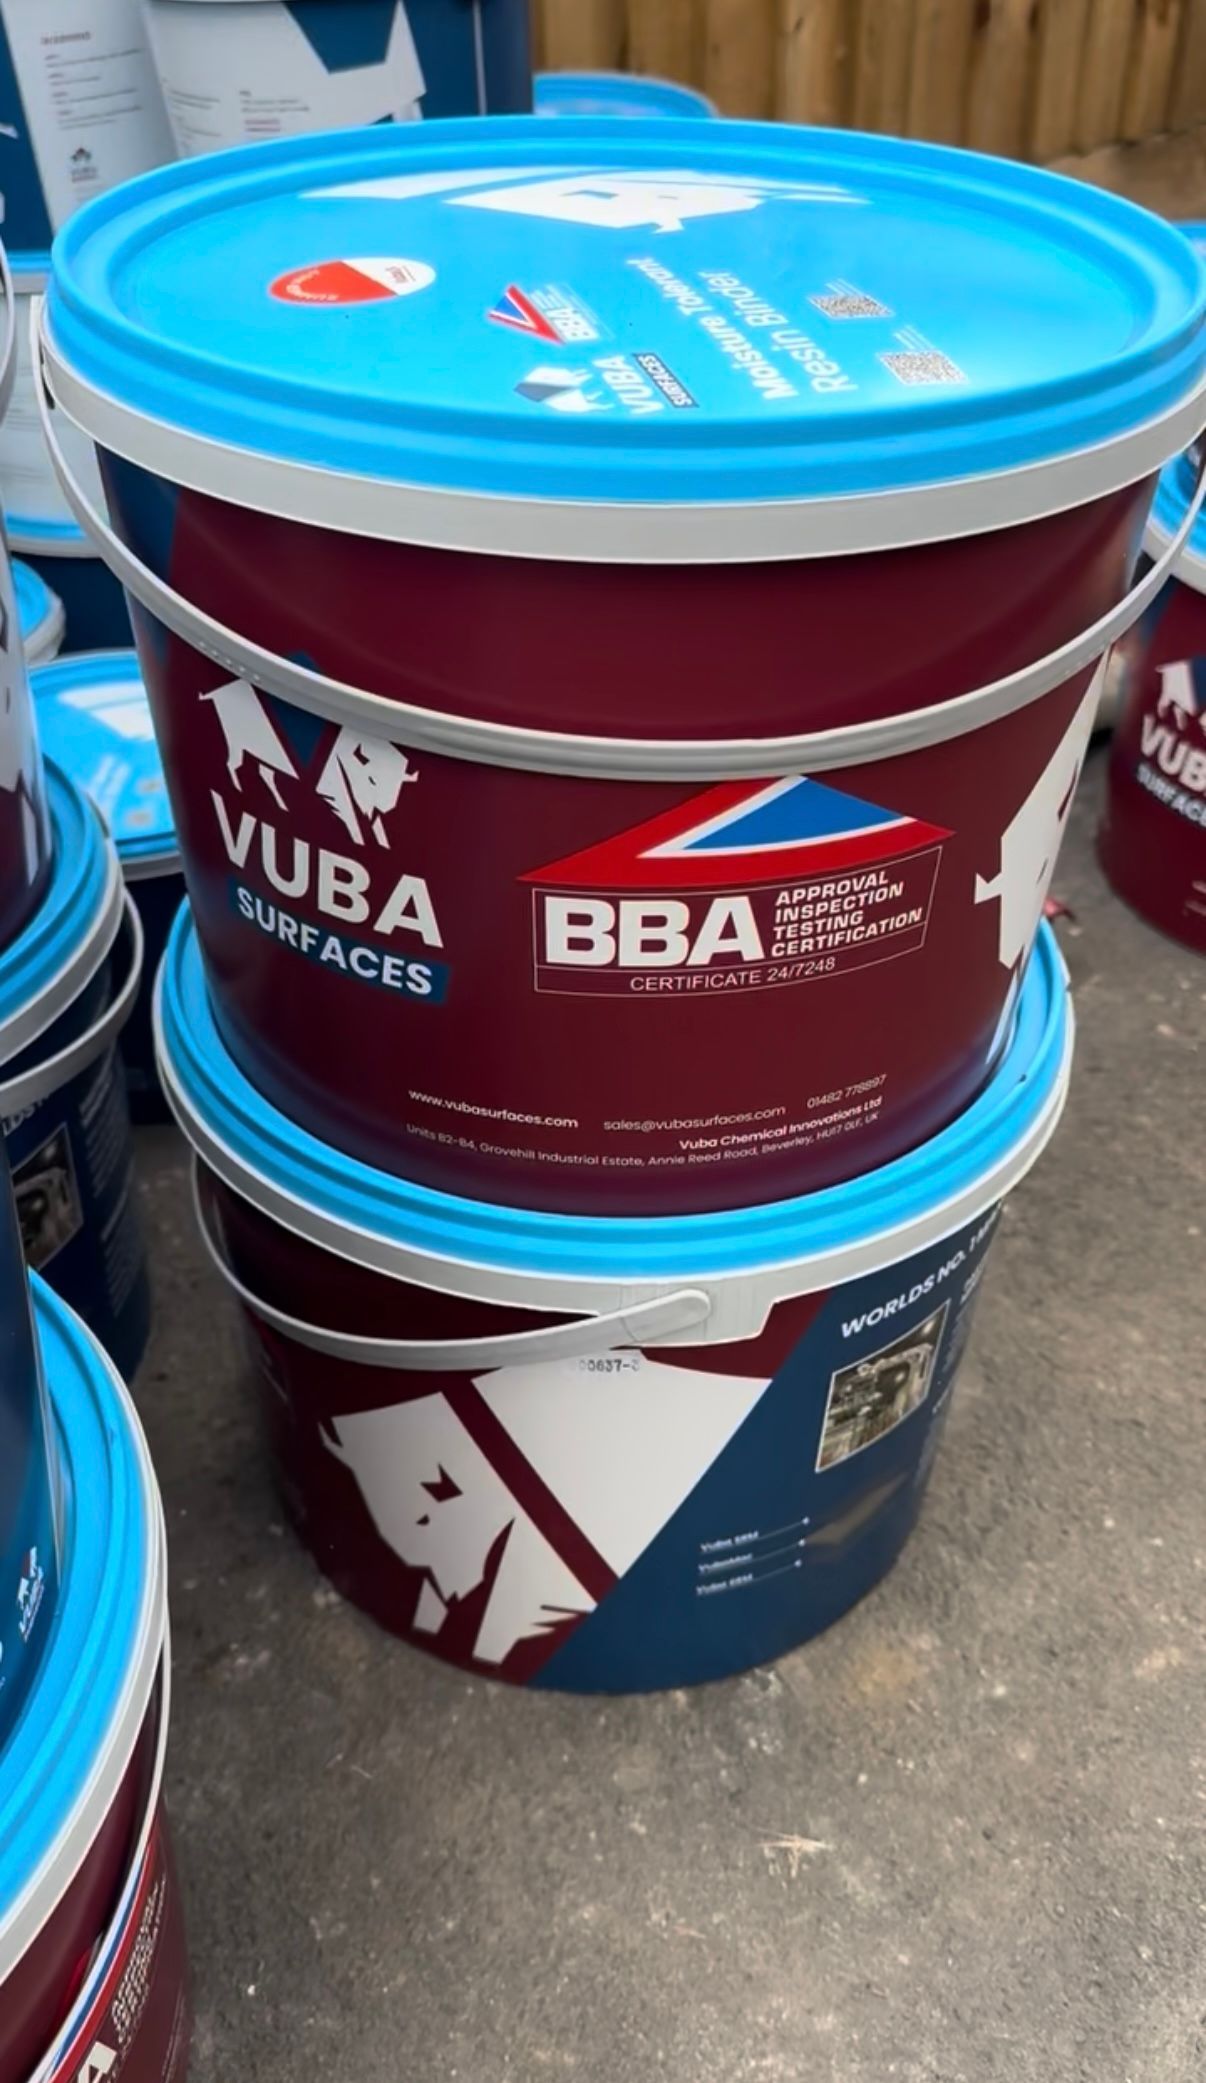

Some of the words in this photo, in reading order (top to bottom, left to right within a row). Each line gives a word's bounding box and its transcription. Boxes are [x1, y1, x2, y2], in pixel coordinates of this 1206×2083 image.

[698, 271, 788, 326] Binder
[592, 356, 665, 413] VUBA
[701, 315, 799, 399] Moisture
[770, 329, 858, 393] Resin
[1141, 713, 1206, 797] VUB
[210, 789, 444, 948] VUBA
[775, 871, 889, 906] APPROVAL
[773, 910, 864, 941] TESTING
[774, 881, 904, 924] INSPECTION
[236, 886, 433, 995] SURFACES
[545, 896, 765, 967] BBA
[771, 907, 923, 958] CERTIFICATION
[630, 970, 761, 992] CERTIFICATE
[767, 956, 836, 982] 24/7248
[408, 1090, 579, 1128] www.vubasurfaces.com
[603, 1106, 786, 1133] sales@vubasurfaces.com
[806, 1090, 843, 1109] 01482
[680, 1137, 717, 1150] Vuba
[720, 1125, 787, 1147] Chemical
[789, 1104, 862, 1135] Innovations
[863, 1096, 883, 1112] Ltd
[406, 1123, 436, 1140] Units
[479, 1142, 536, 1160] Grovehill
[538, 1151, 599, 1166] Industrial
[601, 1156, 645, 1168] Estate,
[648, 1154, 685, 1166] Annie
[688, 1151, 721, 1163] Reed
[723, 1146, 758, 1161] Road,
[761, 1133, 814, 1155] Beverley,
[841, 1274, 936, 1338] WORLDS
